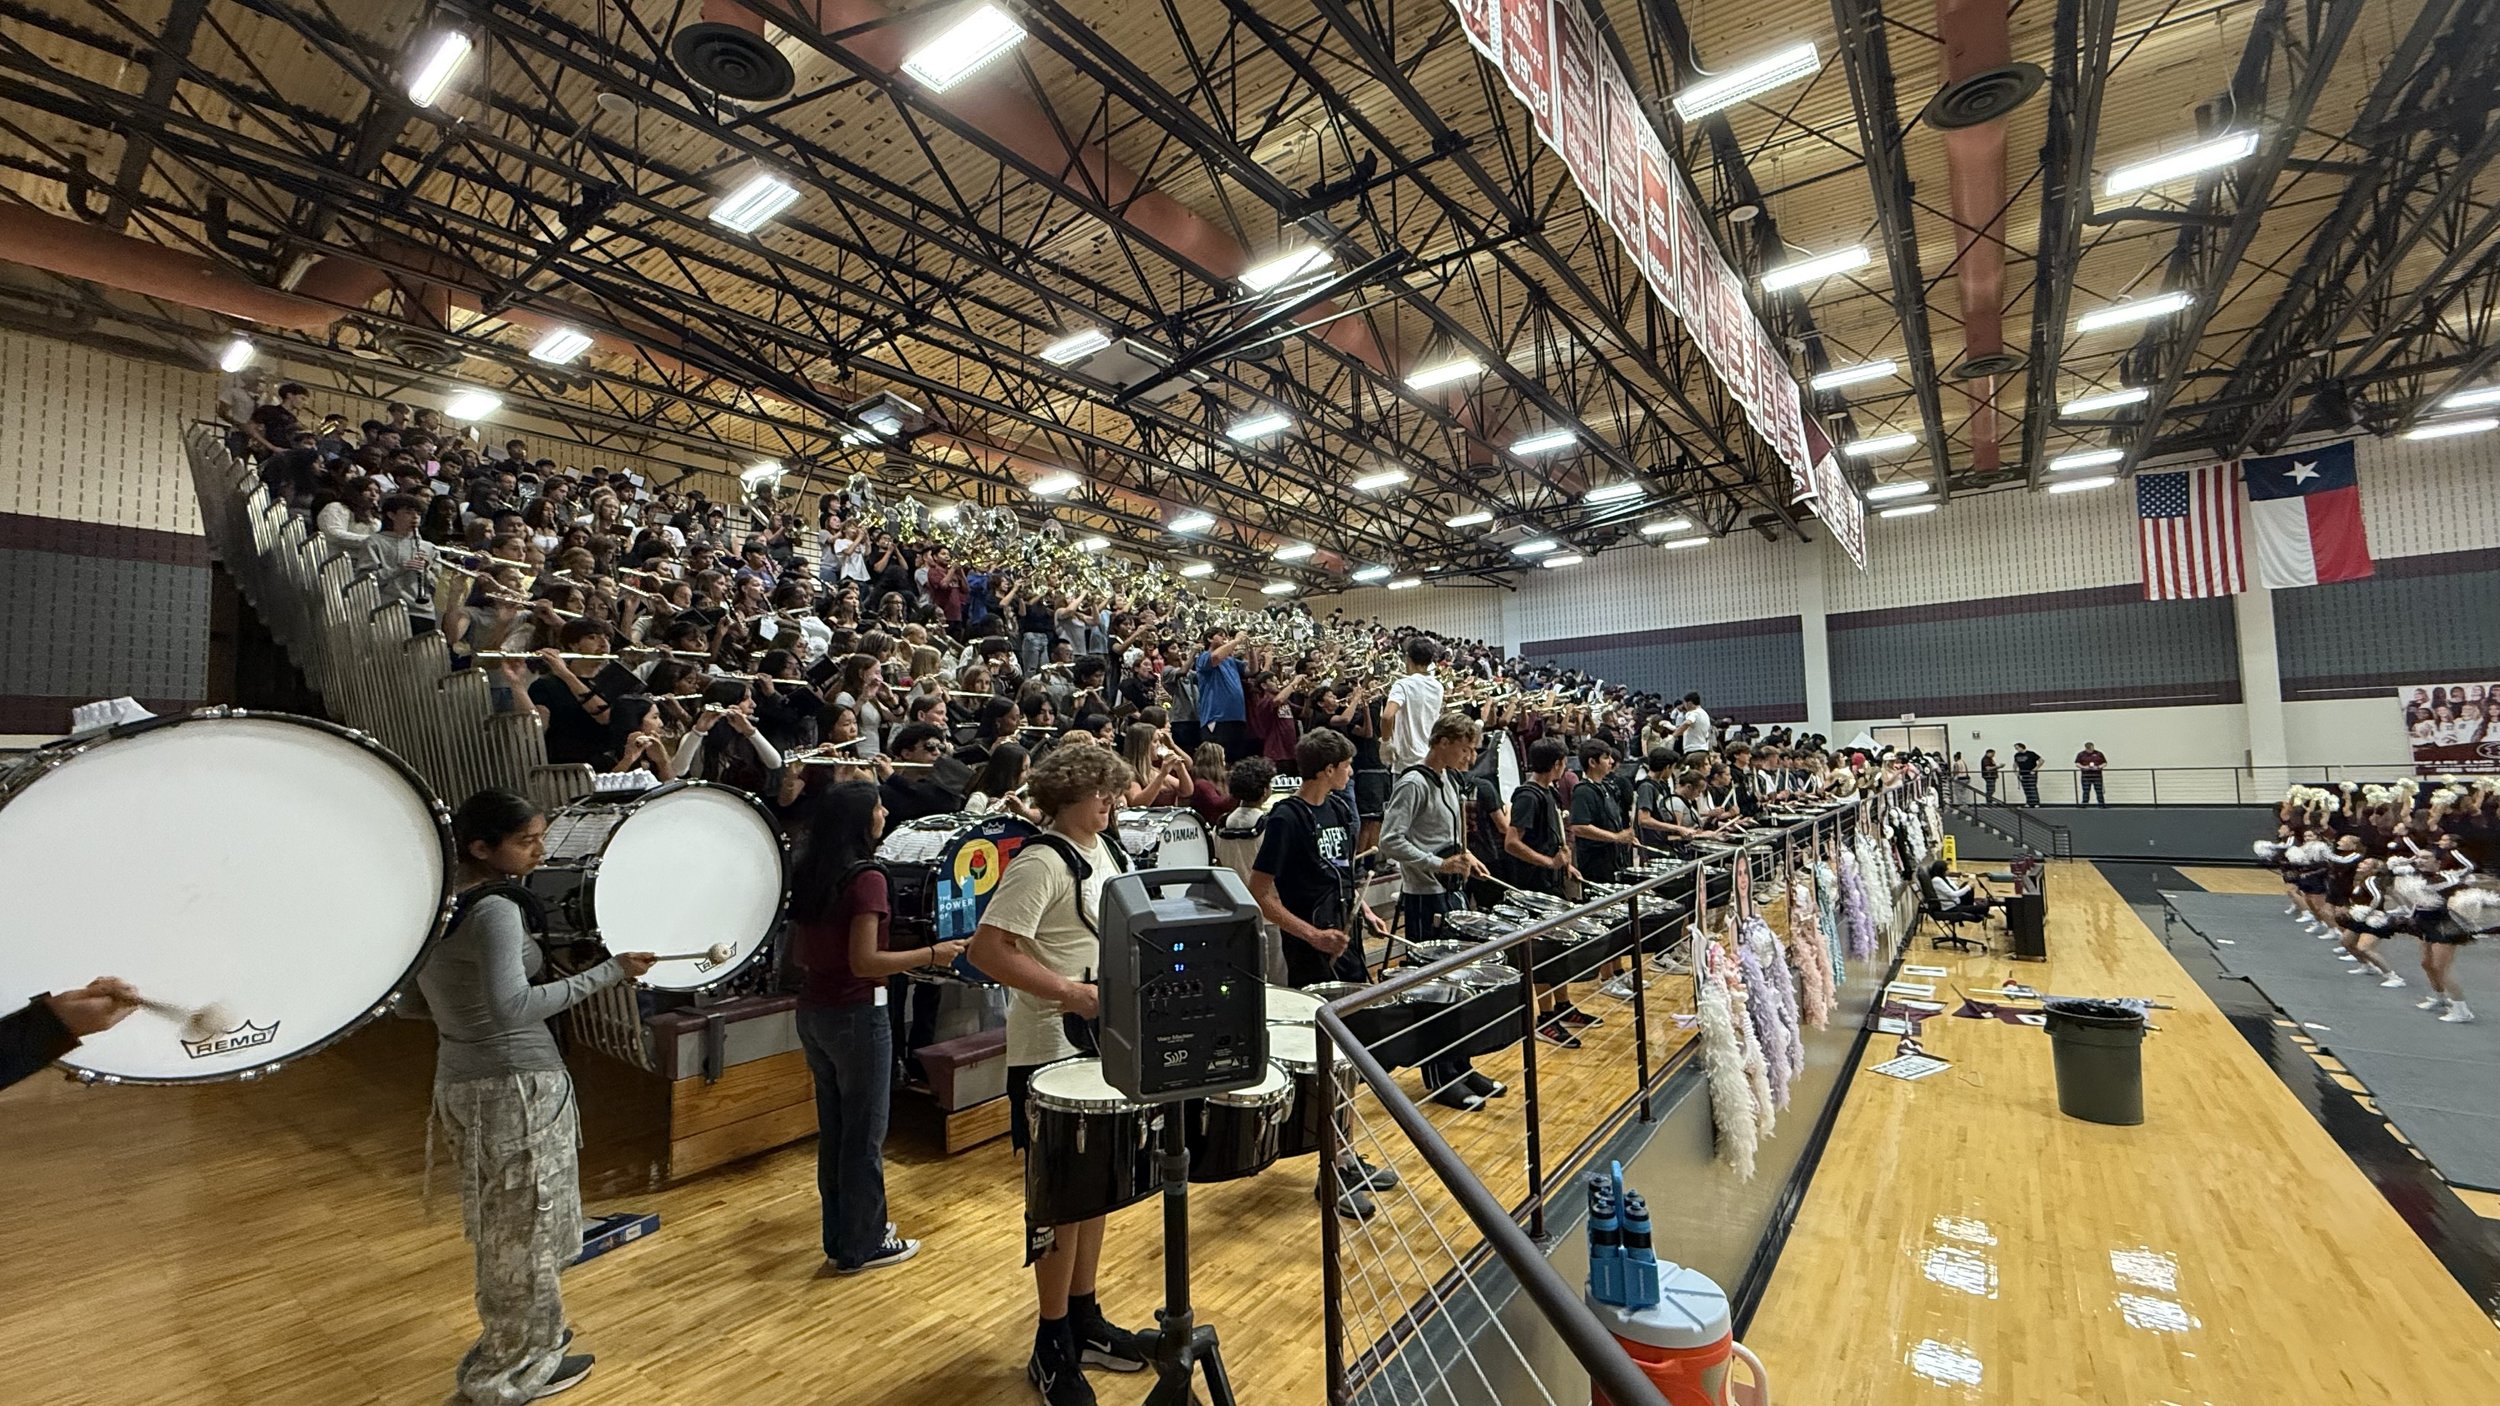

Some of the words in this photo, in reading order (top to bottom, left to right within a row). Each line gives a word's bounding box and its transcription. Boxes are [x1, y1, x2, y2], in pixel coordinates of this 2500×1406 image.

[1172, 827, 1199, 843] YAMAHA
[1319, 841, 1342, 859] EDE
[939, 898, 974, 912] POWER
[938, 912, 949, 920] OF
[196, 1032, 267, 1054] REMO
